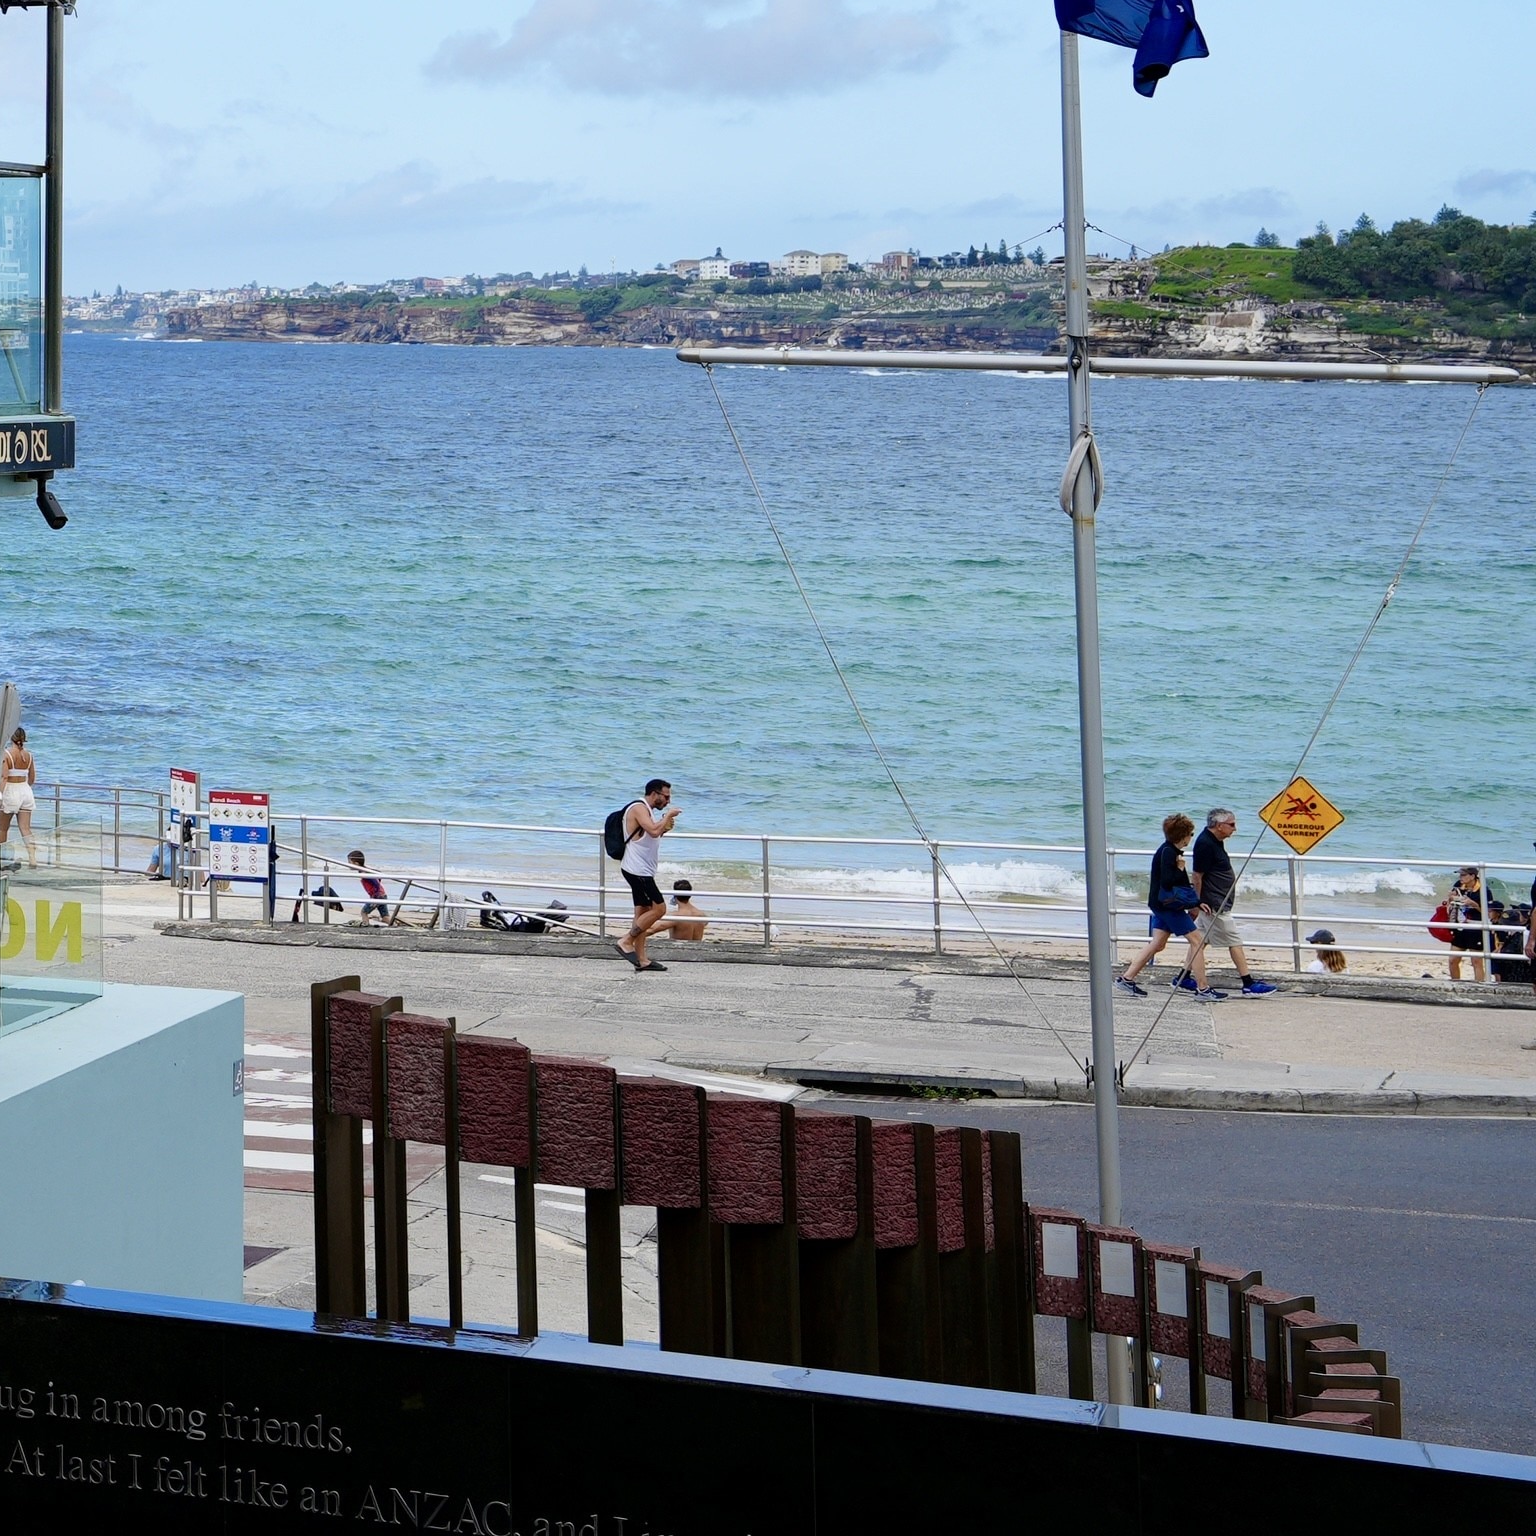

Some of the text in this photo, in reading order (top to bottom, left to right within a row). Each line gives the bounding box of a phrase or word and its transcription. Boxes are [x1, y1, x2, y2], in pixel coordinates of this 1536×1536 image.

[30, 429, 52, 462] RSL
[1277, 823, 1325, 831] DANGEROUS
[45, 1380, 81, 1420] in
[91, 1396, 207, 1441] among
[217, 1401, 353, 1455] friends.
[3, 1438, 46, 1477] At
[55, 1444, 117, 1485] last
[128, 1453, 143, 1491] I
[153, 1456, 209, 1498] felt
[218, 1465, 289, 1510] like
[299, 1486, 343, 1517] an
